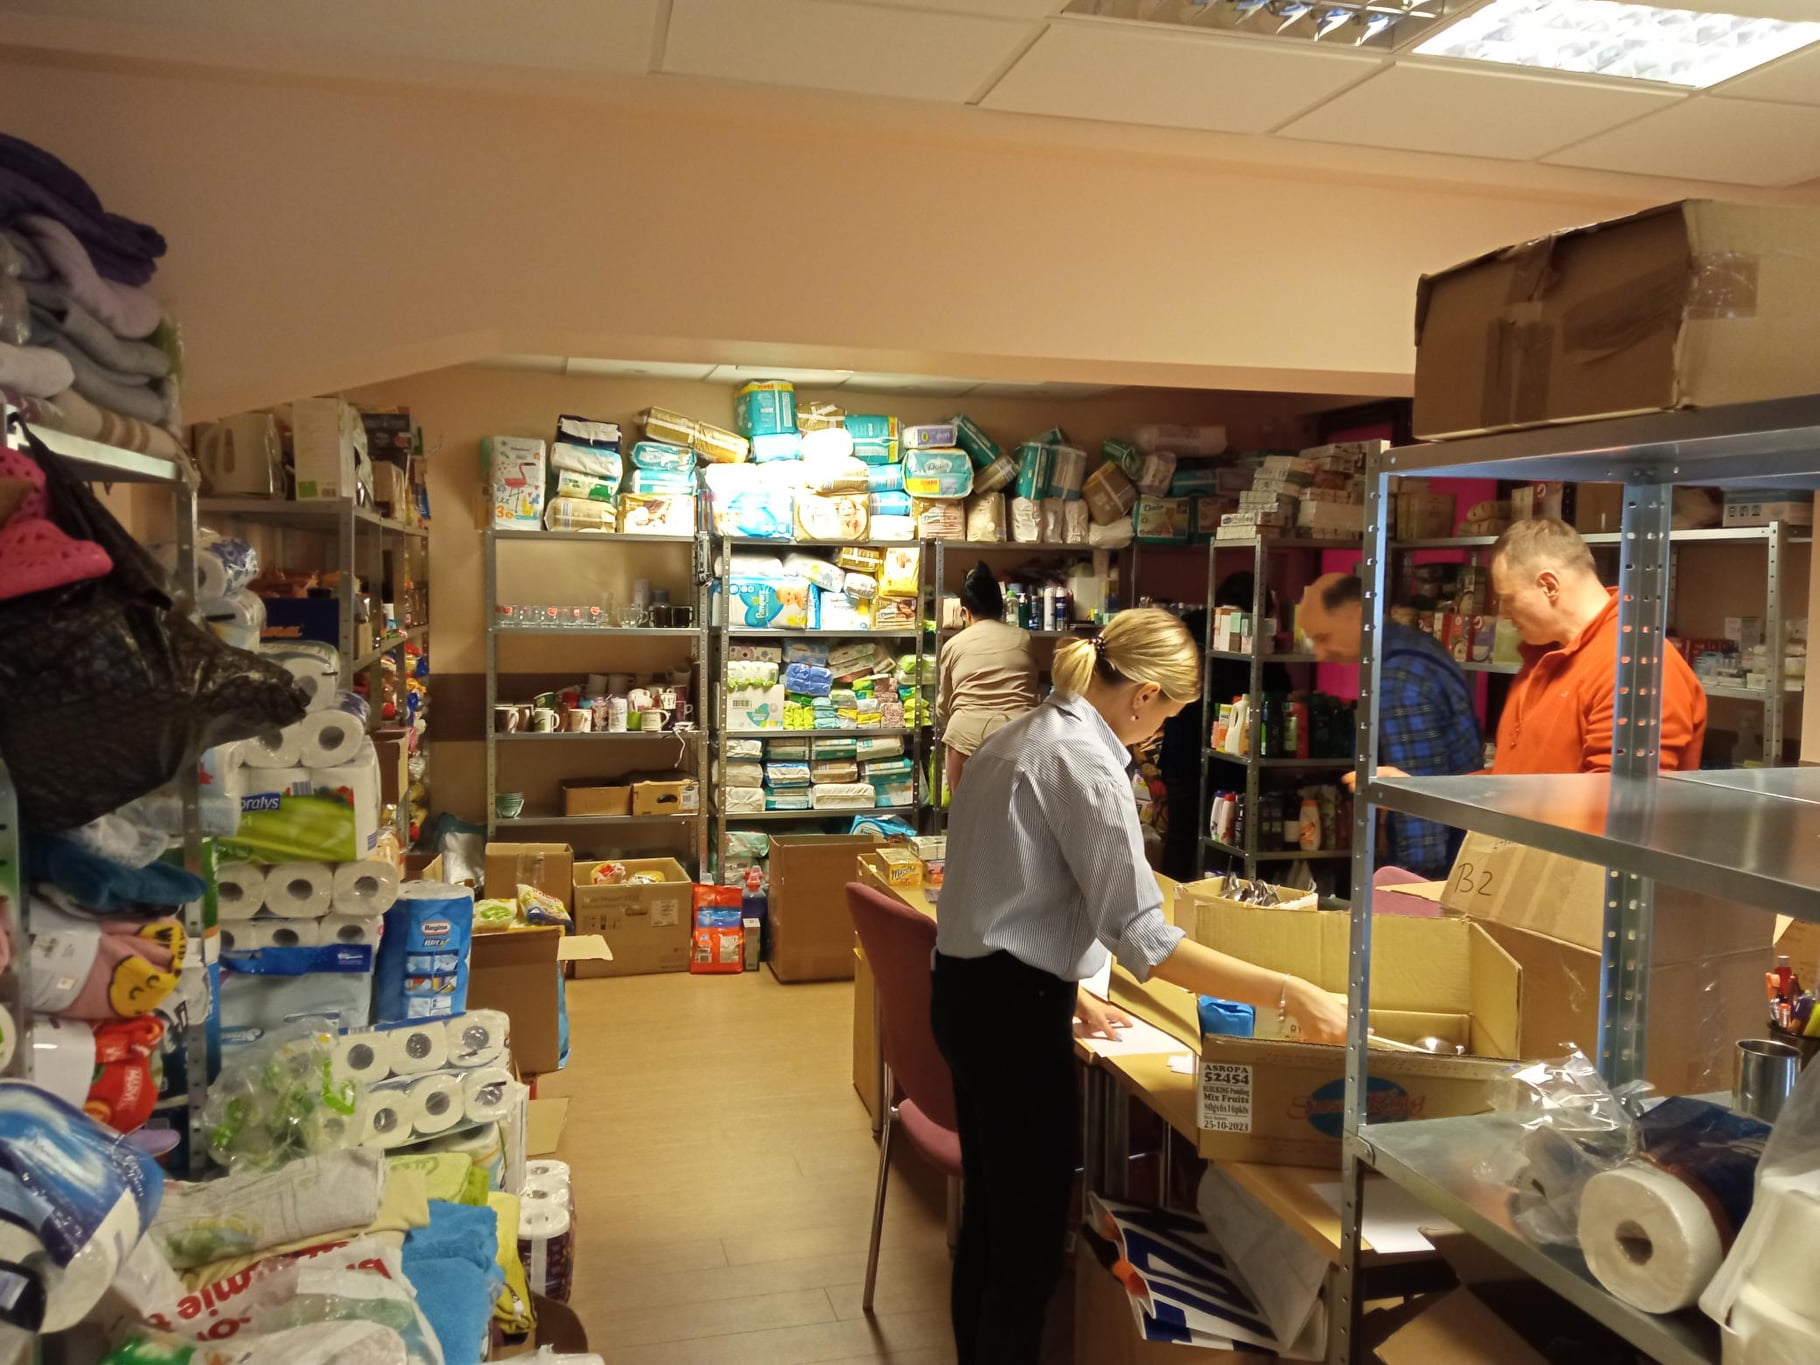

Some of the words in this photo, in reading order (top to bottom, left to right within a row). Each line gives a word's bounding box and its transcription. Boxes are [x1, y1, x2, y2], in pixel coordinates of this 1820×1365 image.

[1455, 862, 1493, 896] B2
[1204, 1072, 1249, 1085] 52454
[1204, 1093, 1220, 1102] Mix
[1221, 1094, 1249, 1104] Fruits
[1203, 1120, 1249, 1132] 25-10-2023
